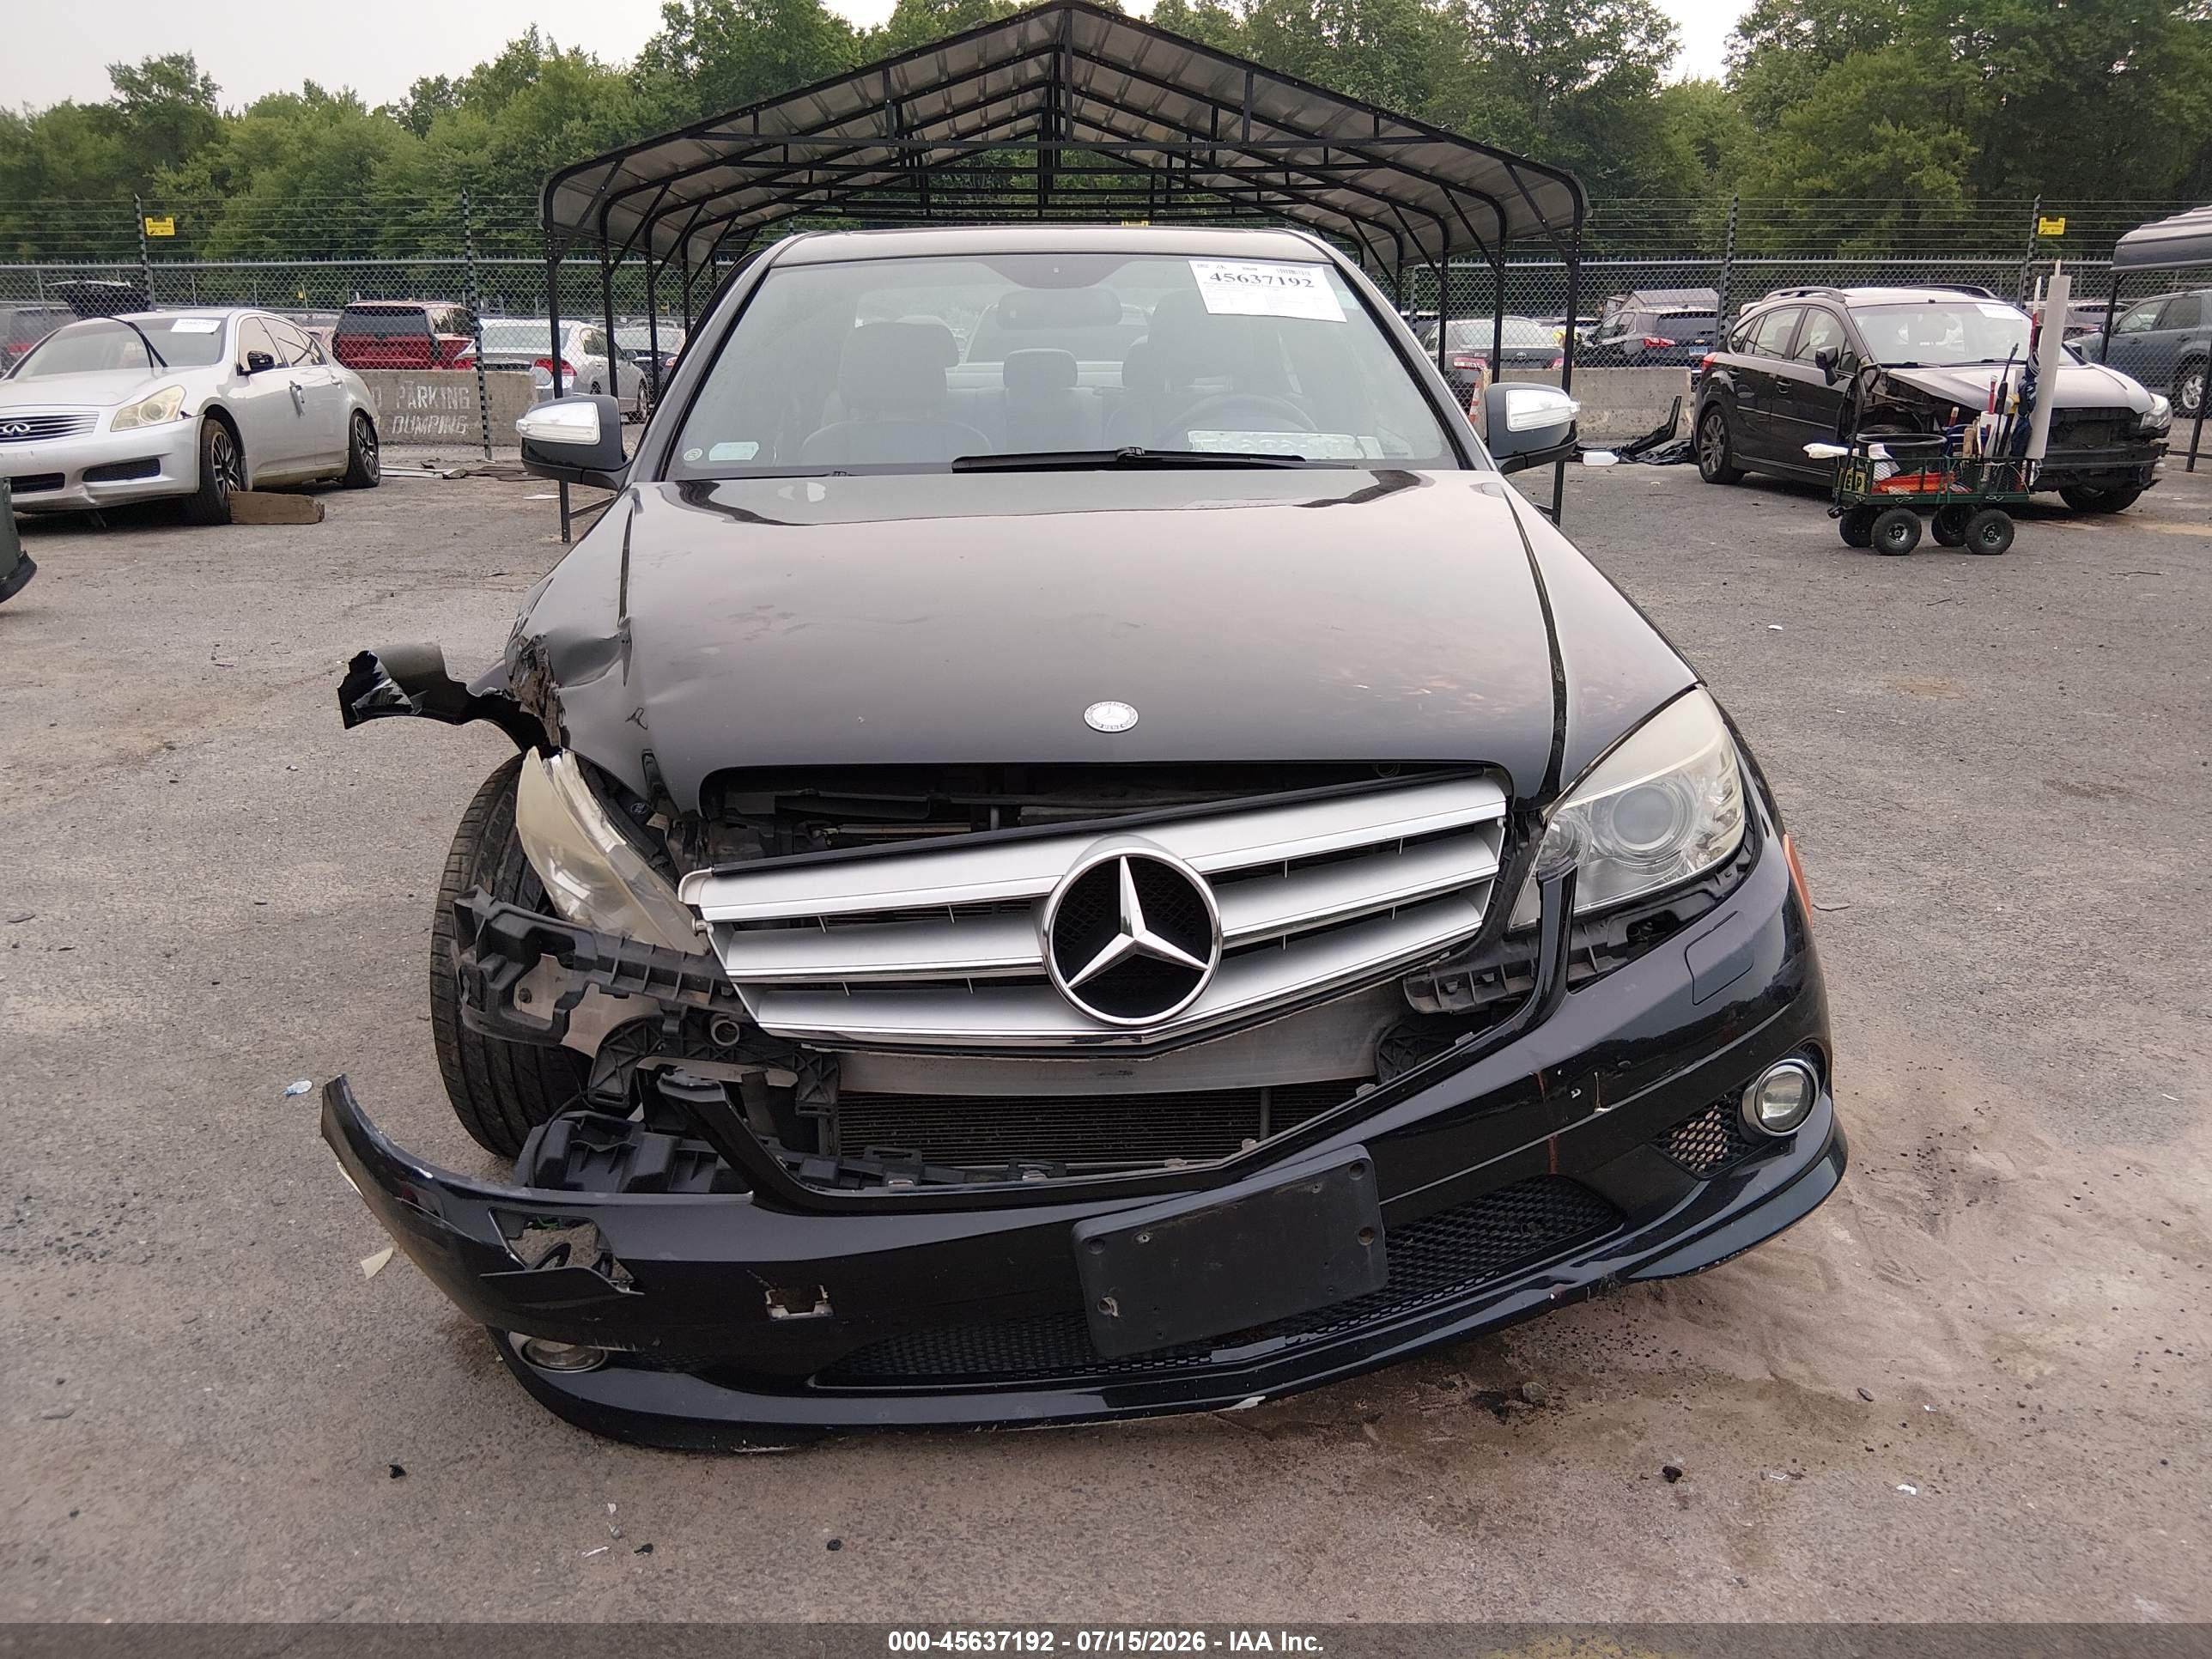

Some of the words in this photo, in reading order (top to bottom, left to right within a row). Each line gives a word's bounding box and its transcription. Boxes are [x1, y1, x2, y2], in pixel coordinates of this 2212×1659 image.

[1209, 272, 1315, 288] 45637192
[396, 383, 471, 410] PARKING
[391, 415, 470, 435] DUMPING
